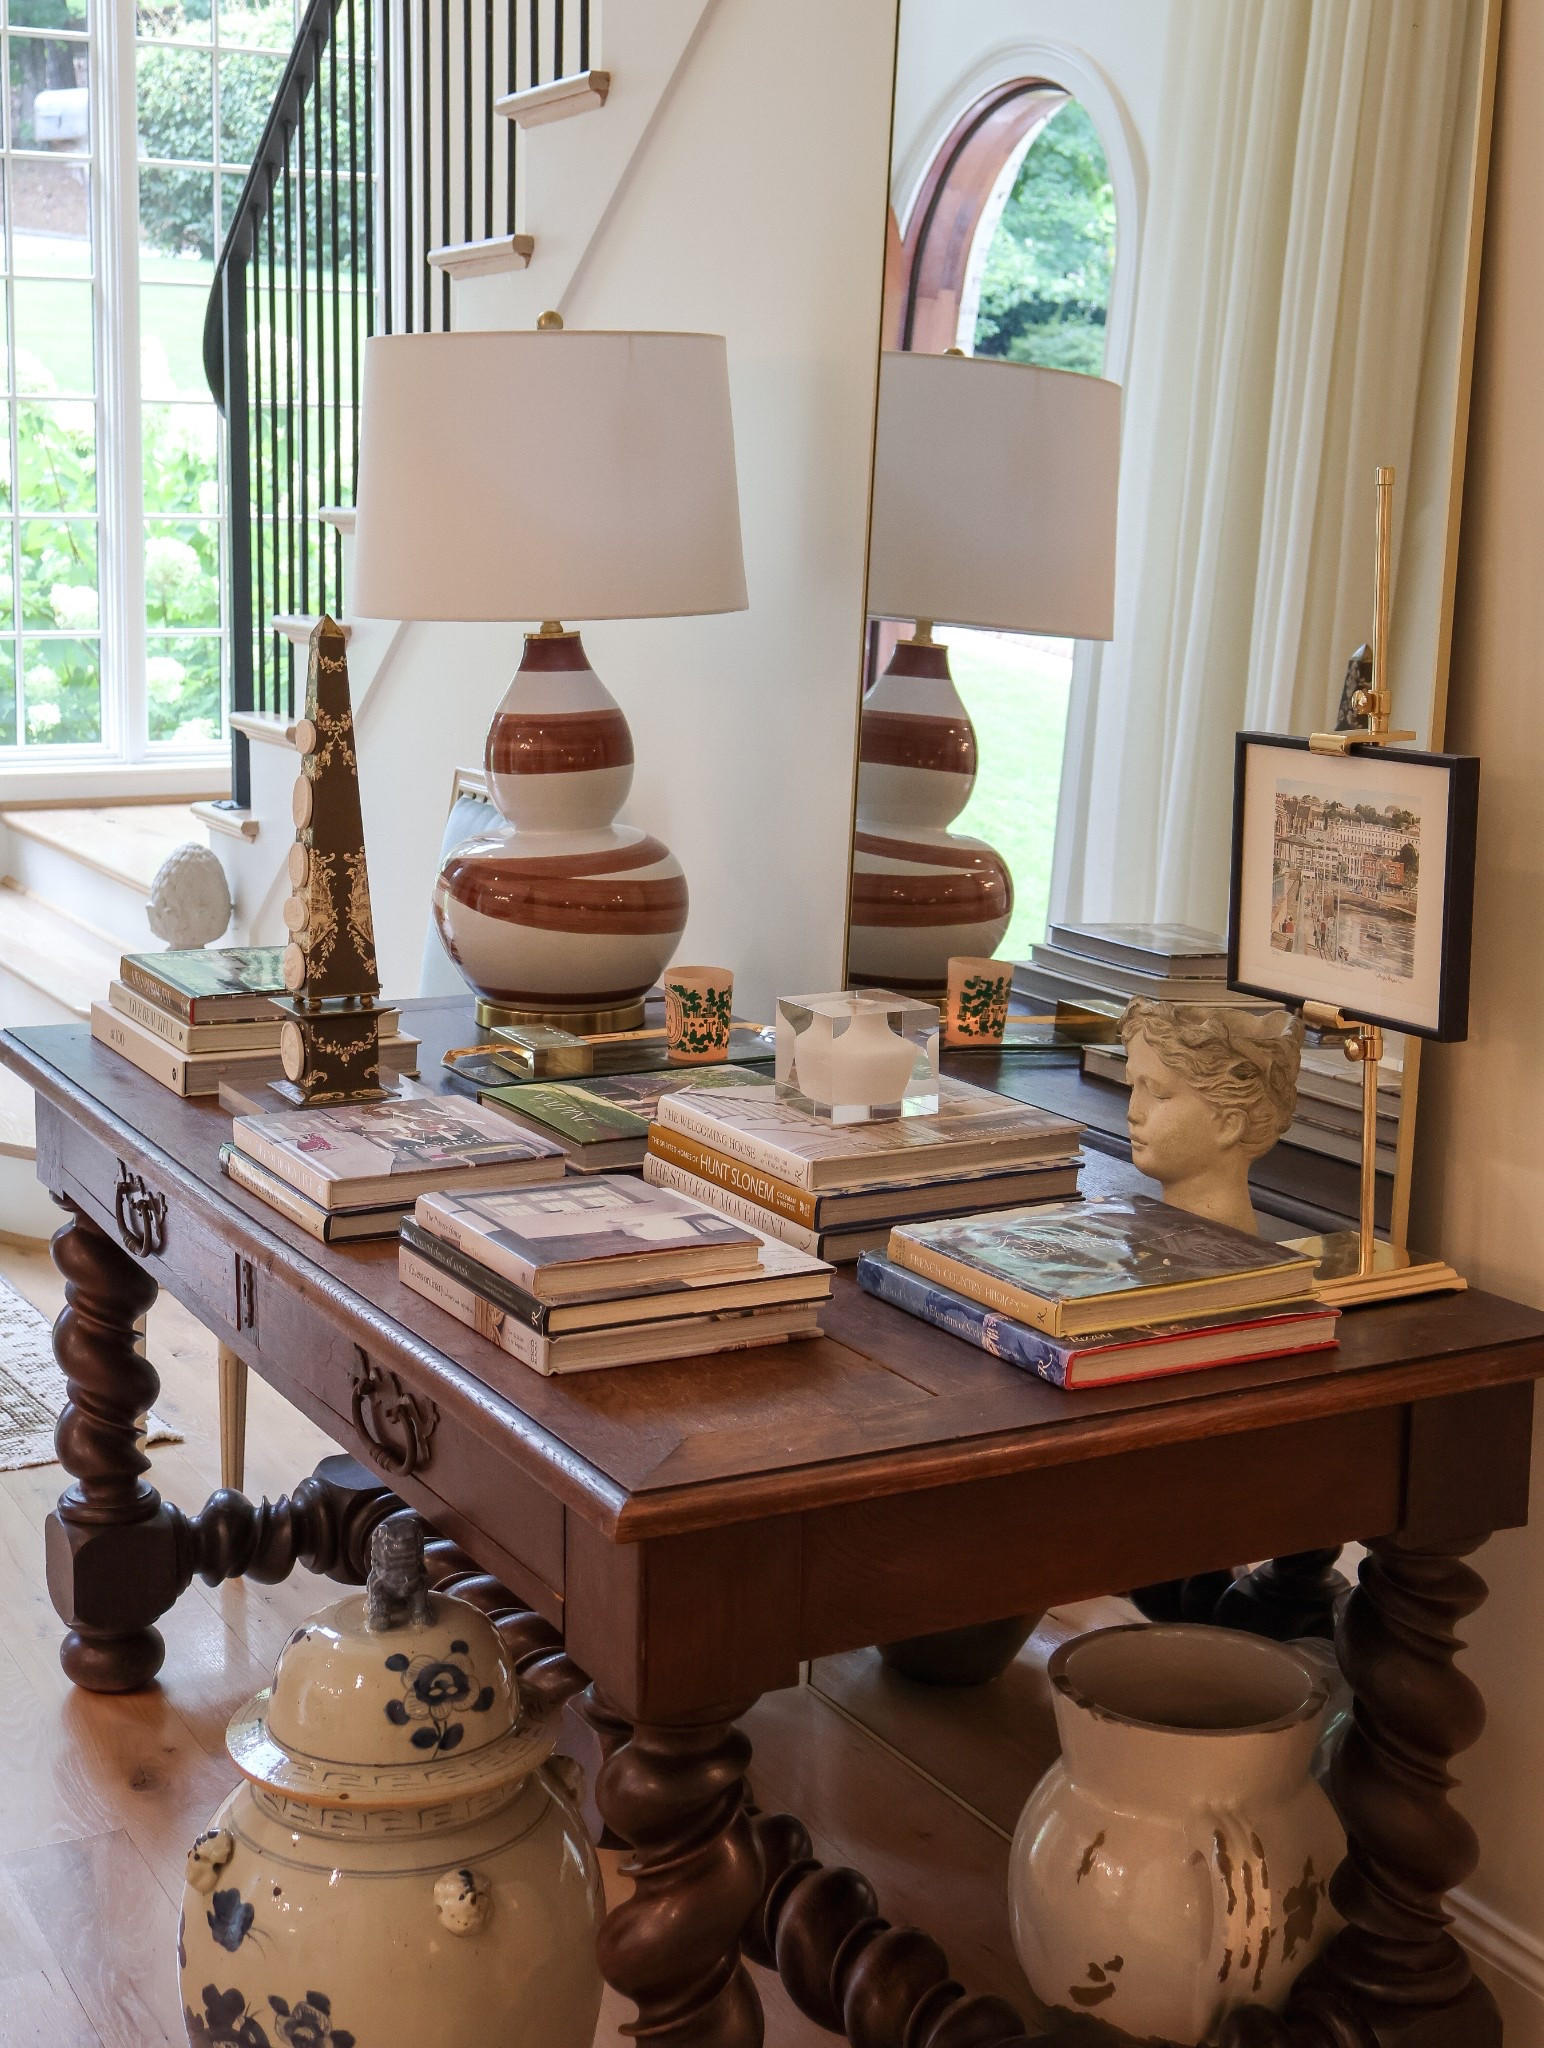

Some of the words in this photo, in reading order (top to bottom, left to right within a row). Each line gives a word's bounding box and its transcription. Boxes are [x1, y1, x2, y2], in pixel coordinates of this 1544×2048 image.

[664, 1108, 678, 1123] THE
[680, 1113, 728, 1146] WELCOMING
[729, 1137, 756, 1160] HOUSE
[651, 1136, 660, 1145] THE
[660, 1139, 677, 1153] SPIRITED
[677, 1149, 692, 1161] HOMES
[692, 1155, 699, 1164] OF
[700, 1153, 731, 1181] HUNT
[731, 1167, 775, 1204] SLONEM
[649, 1158, 670, 1182] THE
[670, 1169, 702, 1197] STYLE
[703, 1185, 719, 1204] OF
[719, 1190, 786, 1238] MOVEMENT
[776, 1191, 797, 1204] COLEMAN
[910, 1253, 941, 1276] FRENCH
[943, 1269, 983, 1295] COUNTRY
[930, 1304, 959, 1329] Elements
[966, 1323, 984, 1340] Style
